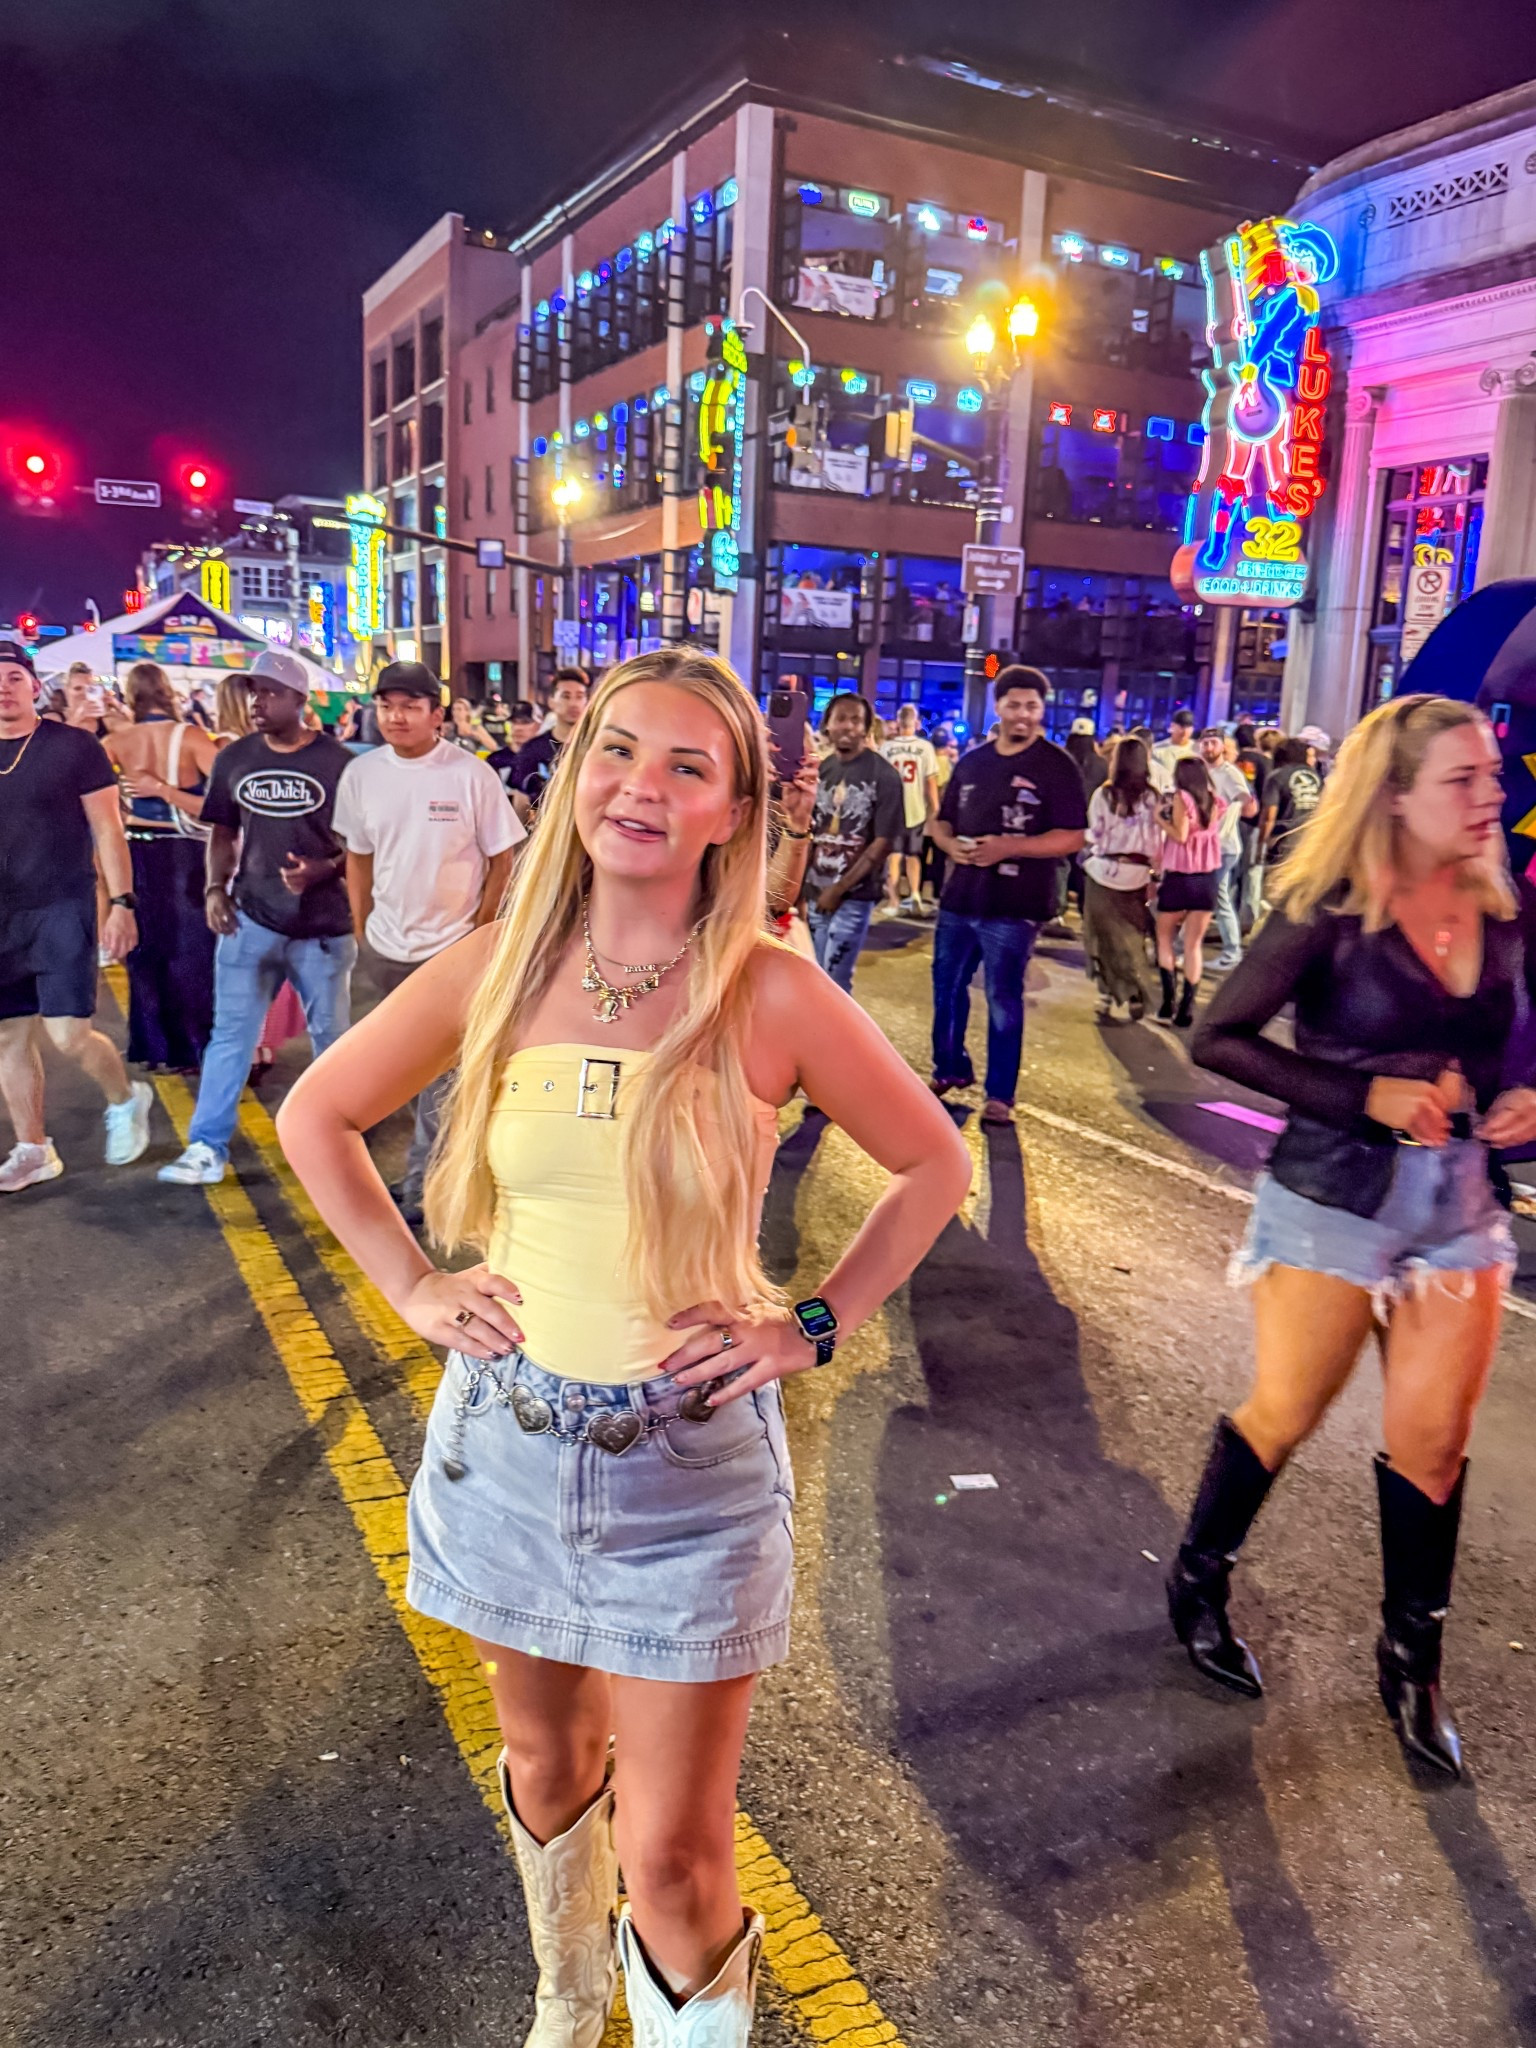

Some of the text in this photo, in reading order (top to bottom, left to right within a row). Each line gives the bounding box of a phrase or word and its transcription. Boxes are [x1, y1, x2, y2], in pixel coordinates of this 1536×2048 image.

[1241, 516, 1303, 562] 32
[1199, 577, 1241, 595] FOOD
[1250, 580, 1304, 599] DRINKS
[245, 779, 312, 804] Von Dutch
